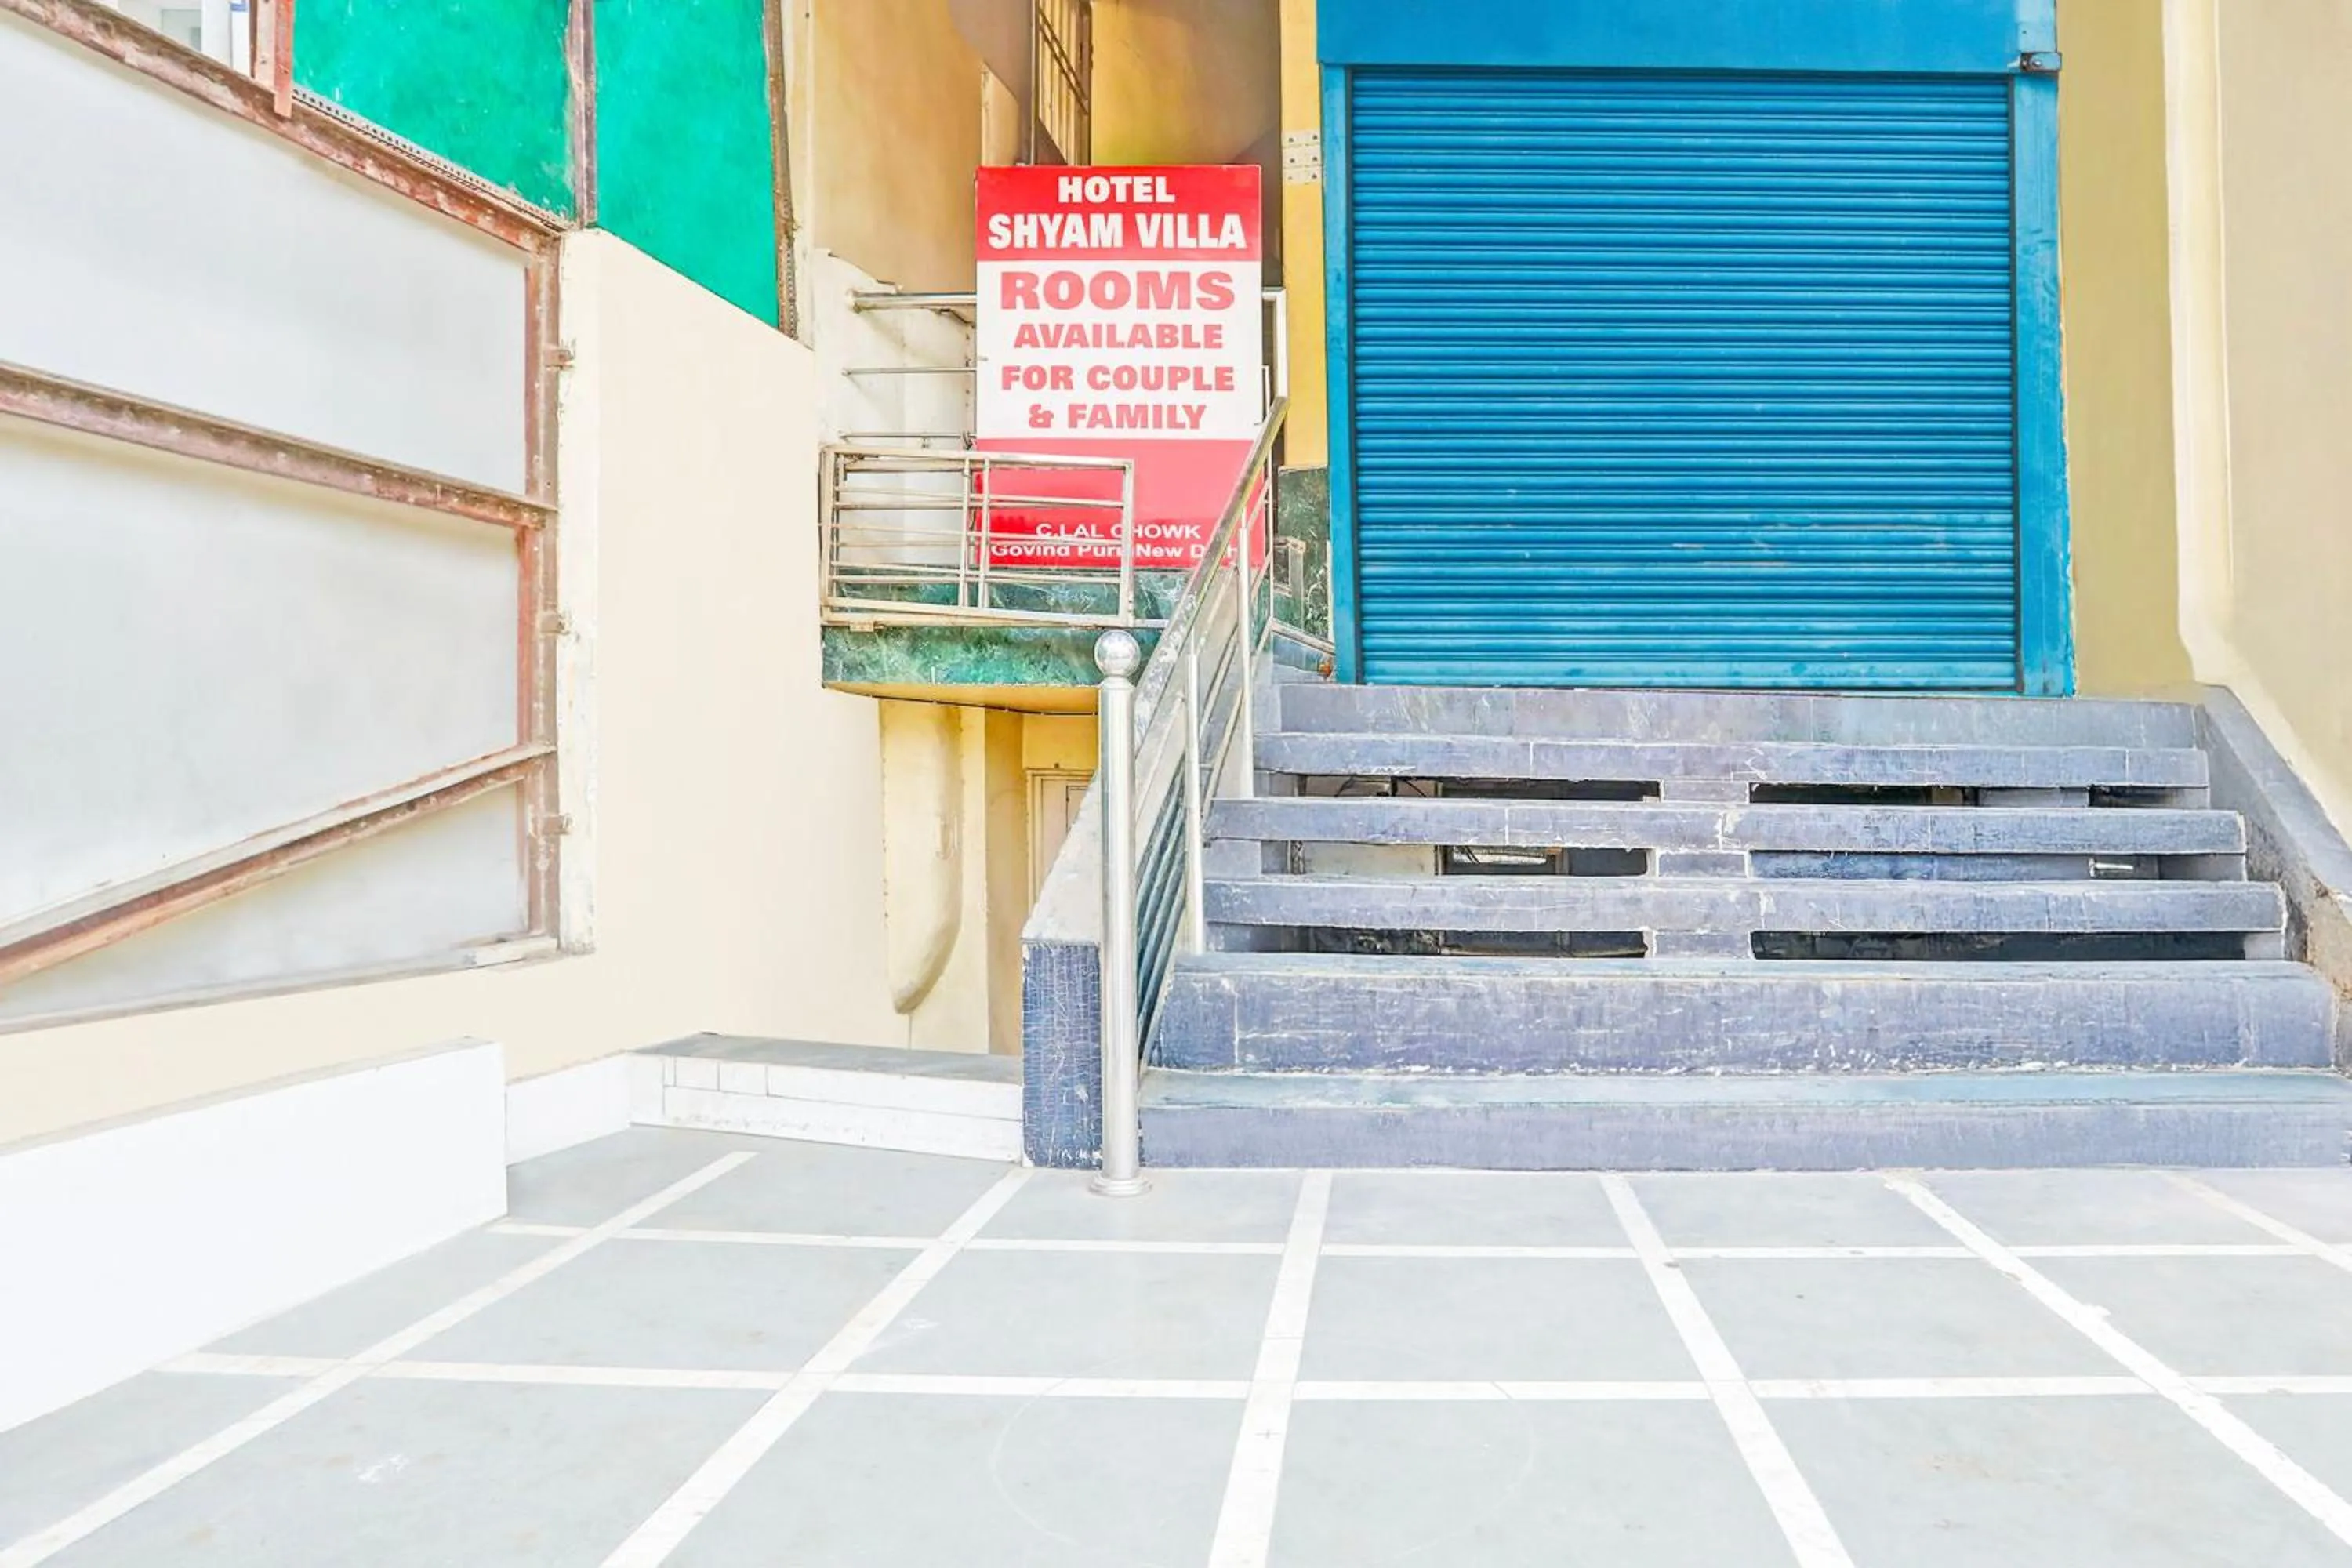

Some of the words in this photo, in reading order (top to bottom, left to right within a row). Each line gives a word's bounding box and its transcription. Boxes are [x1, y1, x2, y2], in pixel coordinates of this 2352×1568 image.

[1058, 176, 1174, 204] HOTEL
[988, 212, 1123, 249] SHYAM
[1136, 213, 1247, 249] VILLA
[1001, 271, 1235, 310] ROOMS
[1014, 324, 1223, 349] AVAILABLE
[1001, 365, 1073, 390] FOR
[1087, 365, 1235, 390] COUPLE
[1028, 404, 1054, 429] &
[1068, 404, 1207, 430] FAMILY
[1136, 543, 1181, 557] New
